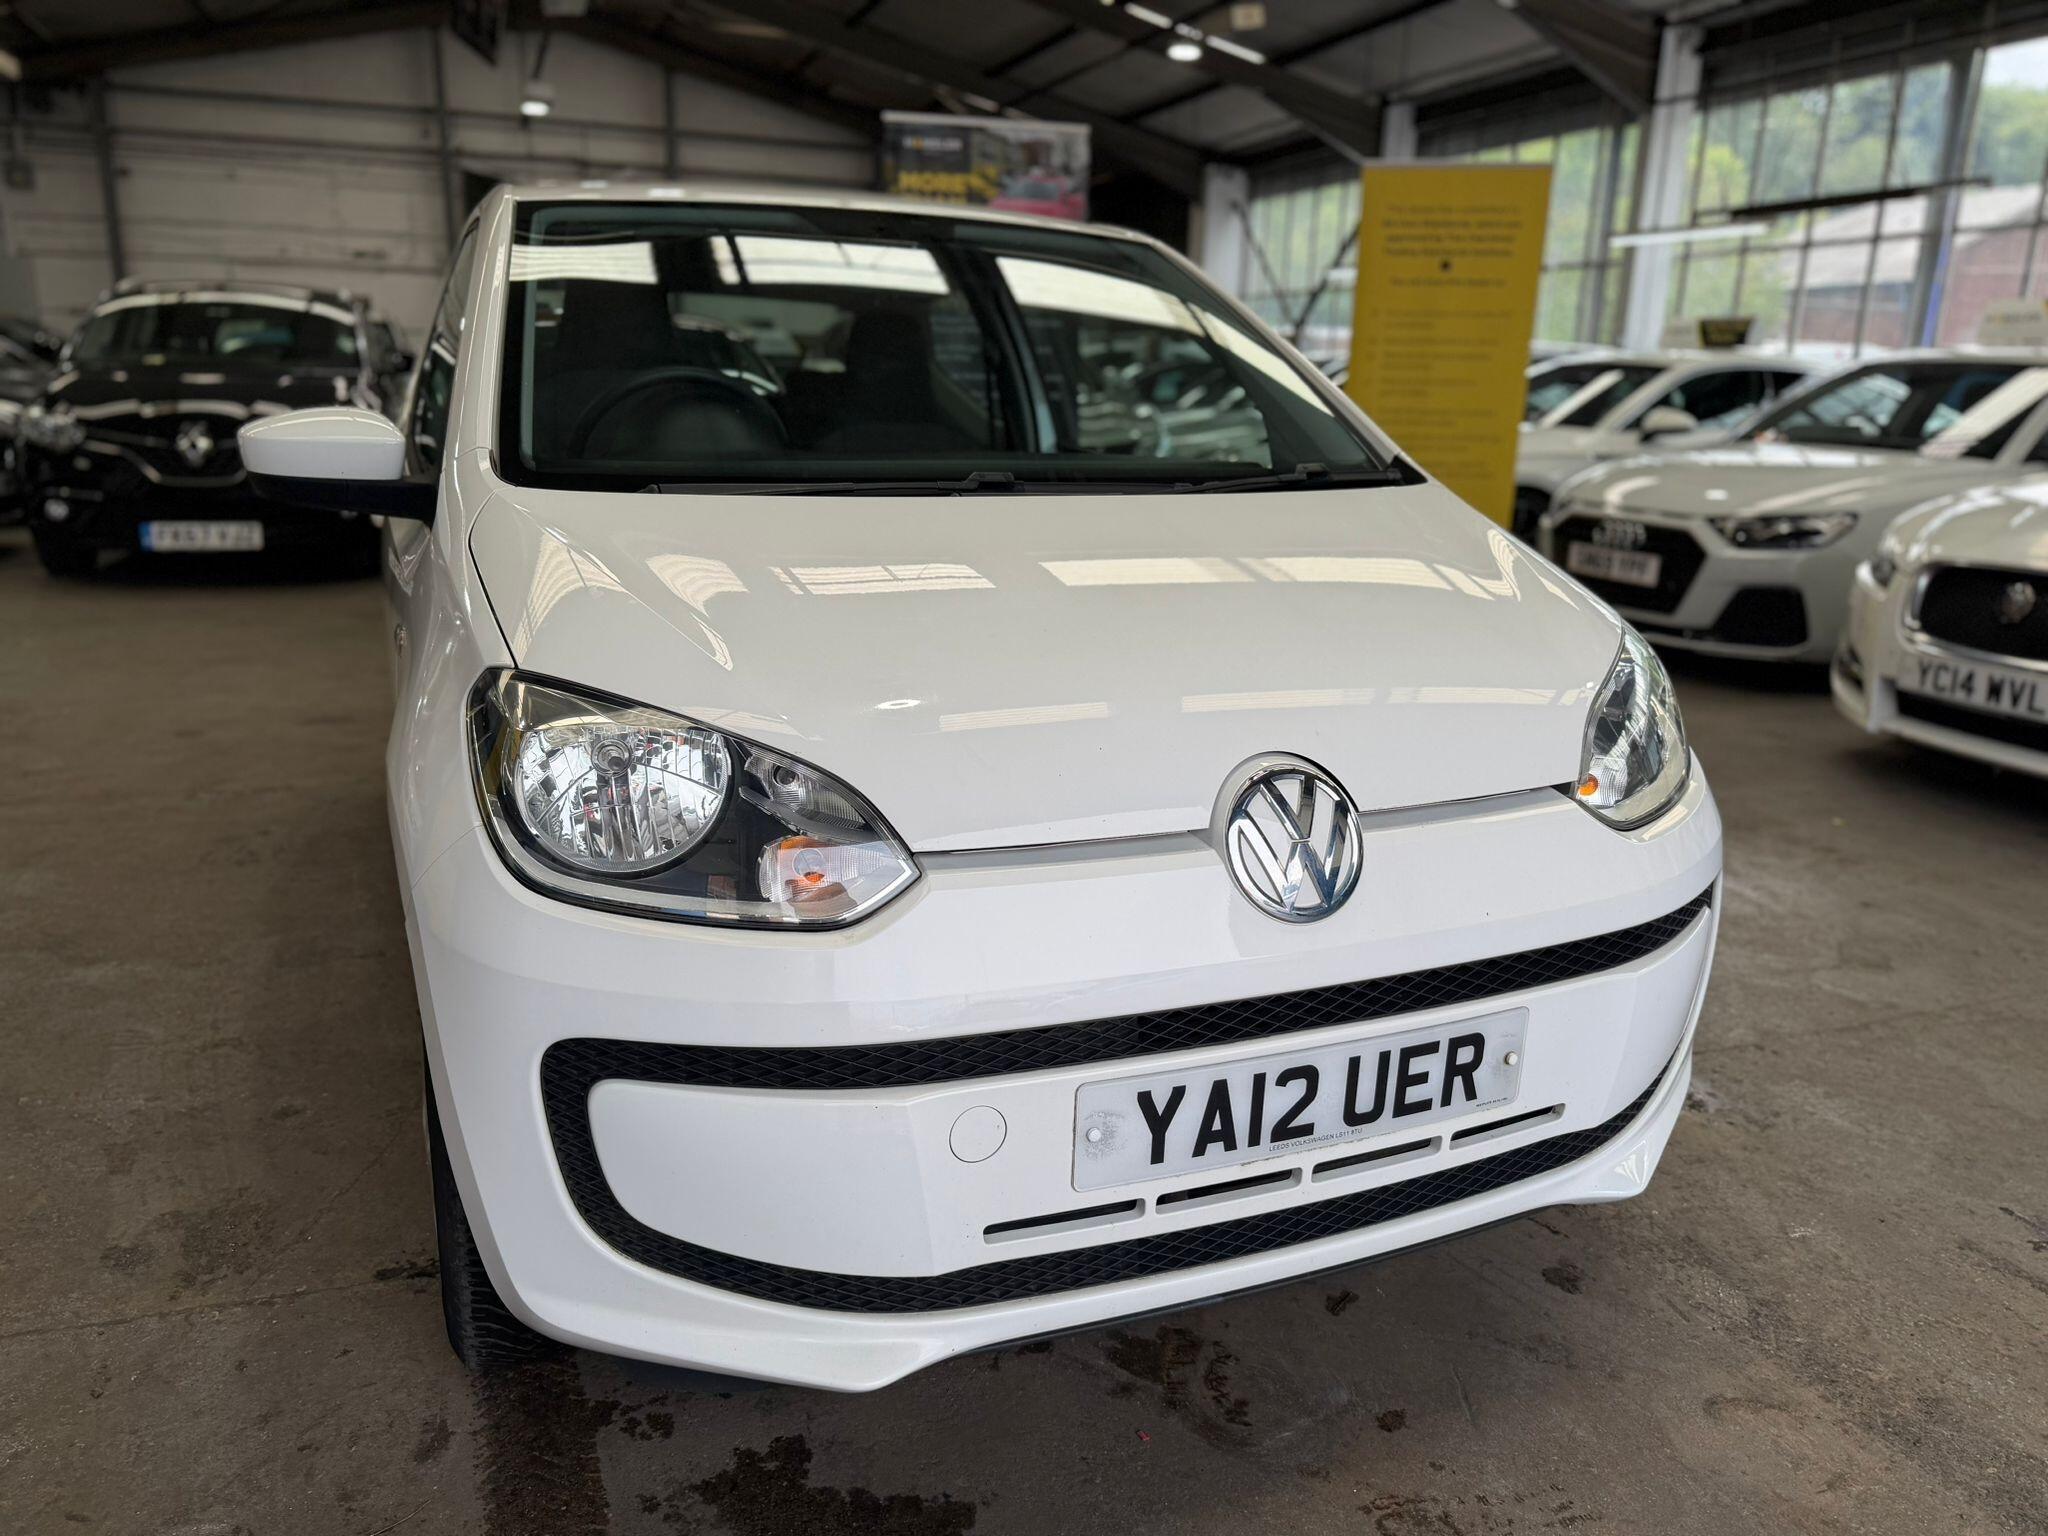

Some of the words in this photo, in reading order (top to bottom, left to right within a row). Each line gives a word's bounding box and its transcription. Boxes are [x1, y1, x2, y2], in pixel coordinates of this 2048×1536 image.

[1918, 659, 1975, 699] YC14
[1137, 1064, 1320, 1165] YA12
[1343, 1032, 1485, 1126] UER
[1269, 1142, 1290, 1152] LEEDS
[1291, 1133, 1335, 1148] VOLKSWAGEN
